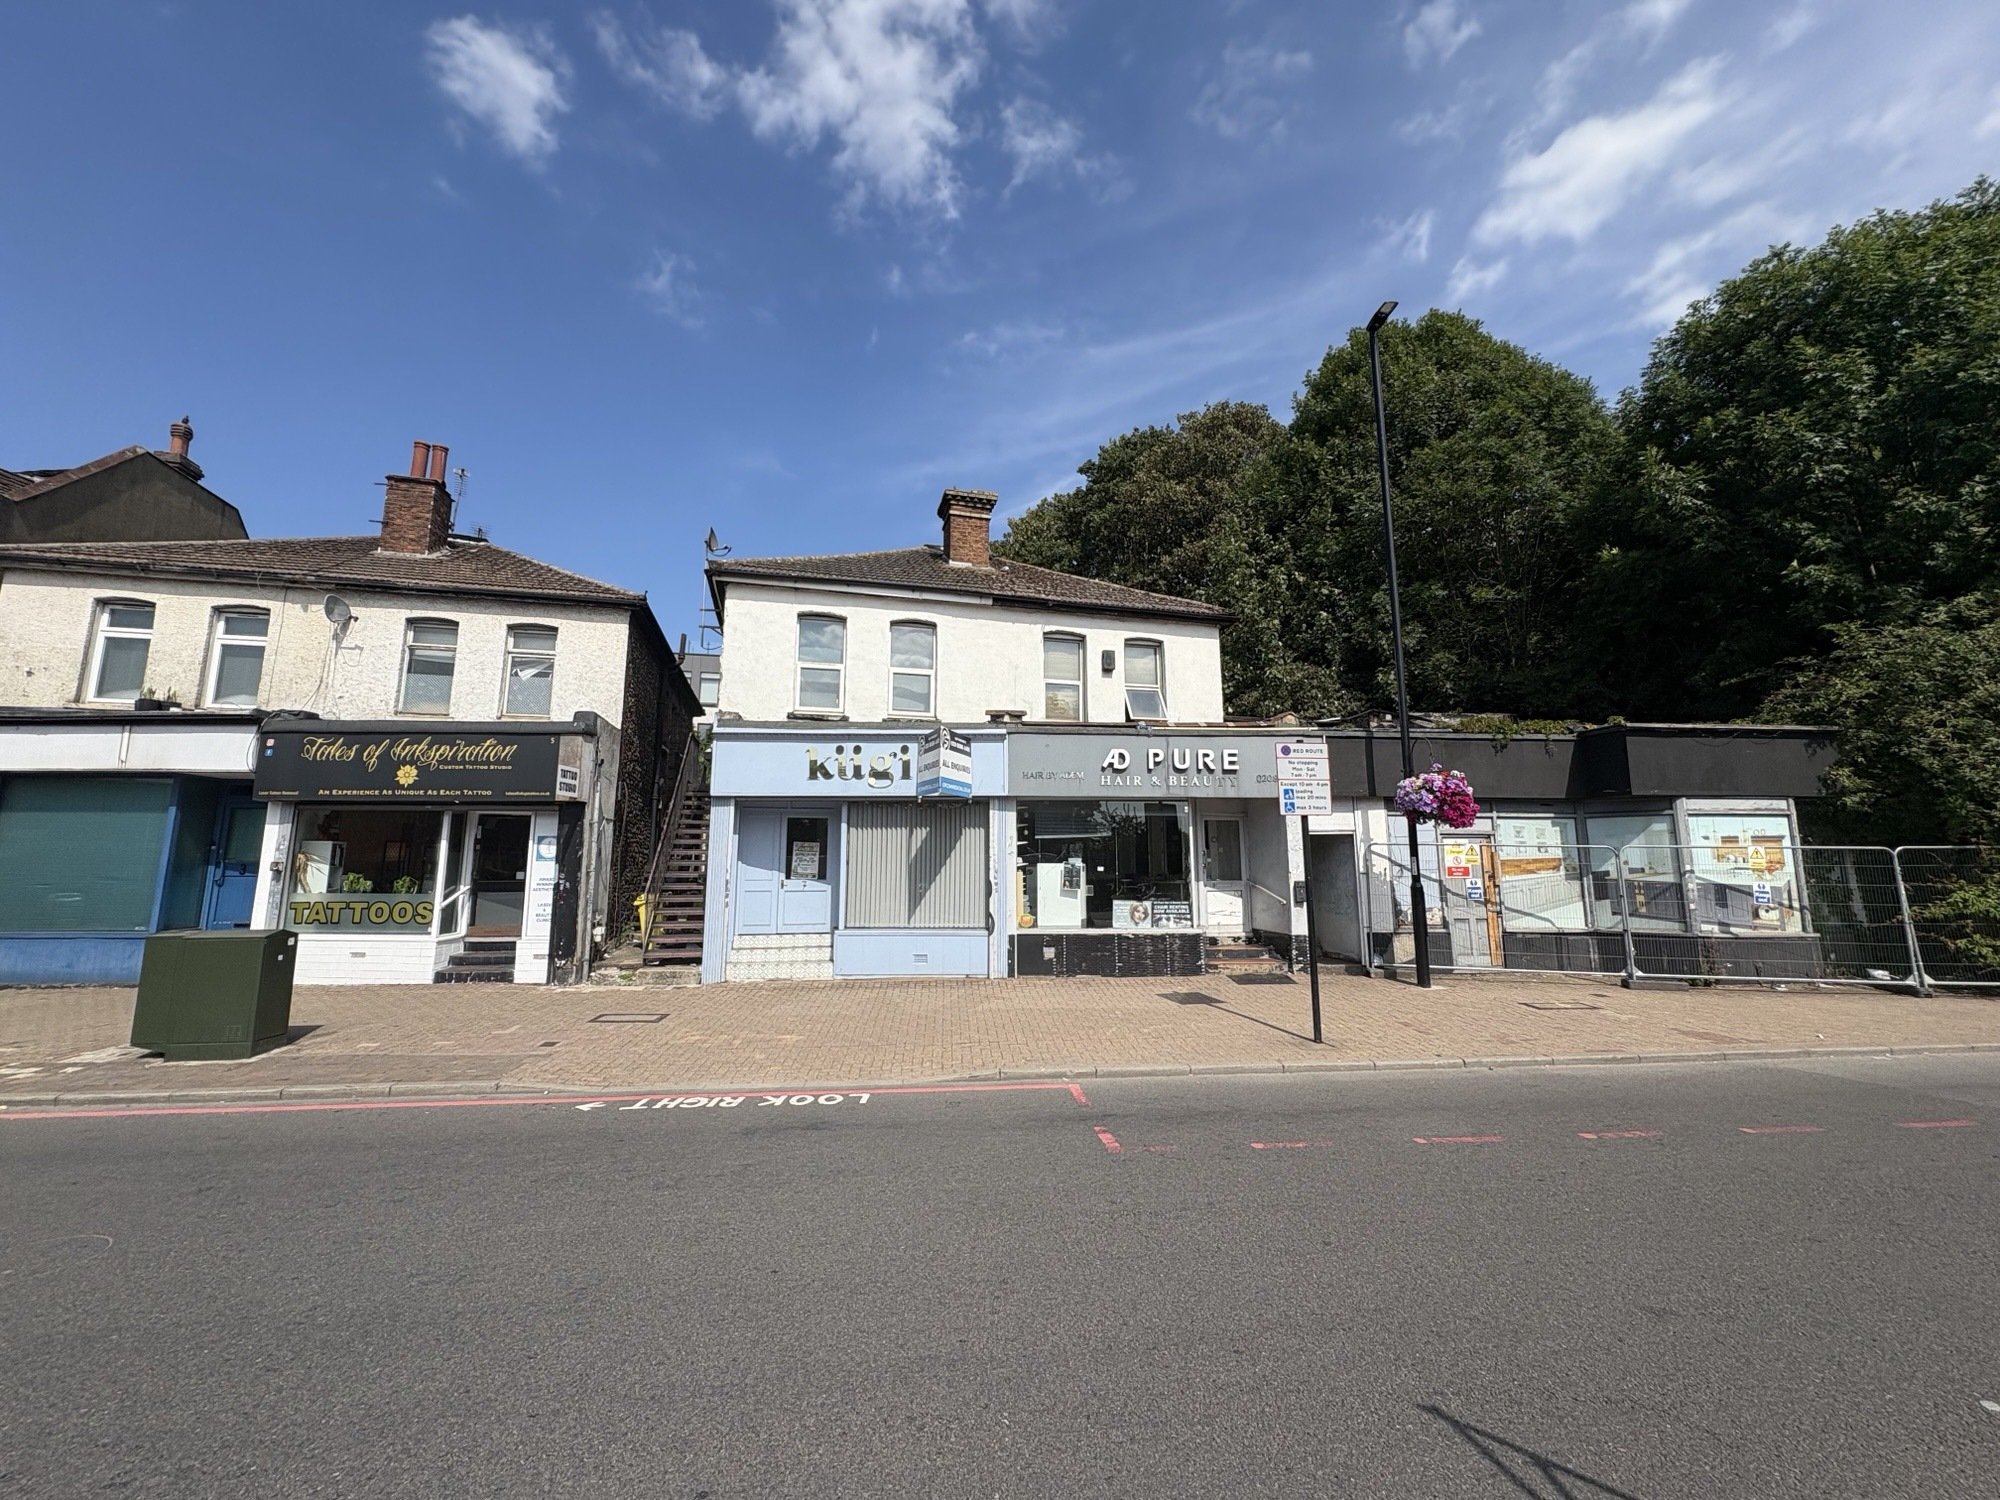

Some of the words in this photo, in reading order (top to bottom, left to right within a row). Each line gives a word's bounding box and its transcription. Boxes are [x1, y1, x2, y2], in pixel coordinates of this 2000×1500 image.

[301, 736, 360, 761] Tales
[363, 738, 390, 772] of
[390, 735, 518, 771] Inkspiration
[1147, 748, 1240, 771] PURE
[805, 744, 912, 789] kügi
[560, 768, 578, 780] TATTOO
[1022, 771, 1044, 780] HAIR
[1100, 775, 1143, 786] HAIR
[1150, 775, 1161, 787] &
[289, 901, 433, 925] TATTOOS
[619, 1096, 747, 1110] RIGHT
[758, 1093, 871, 1106] LOOK
